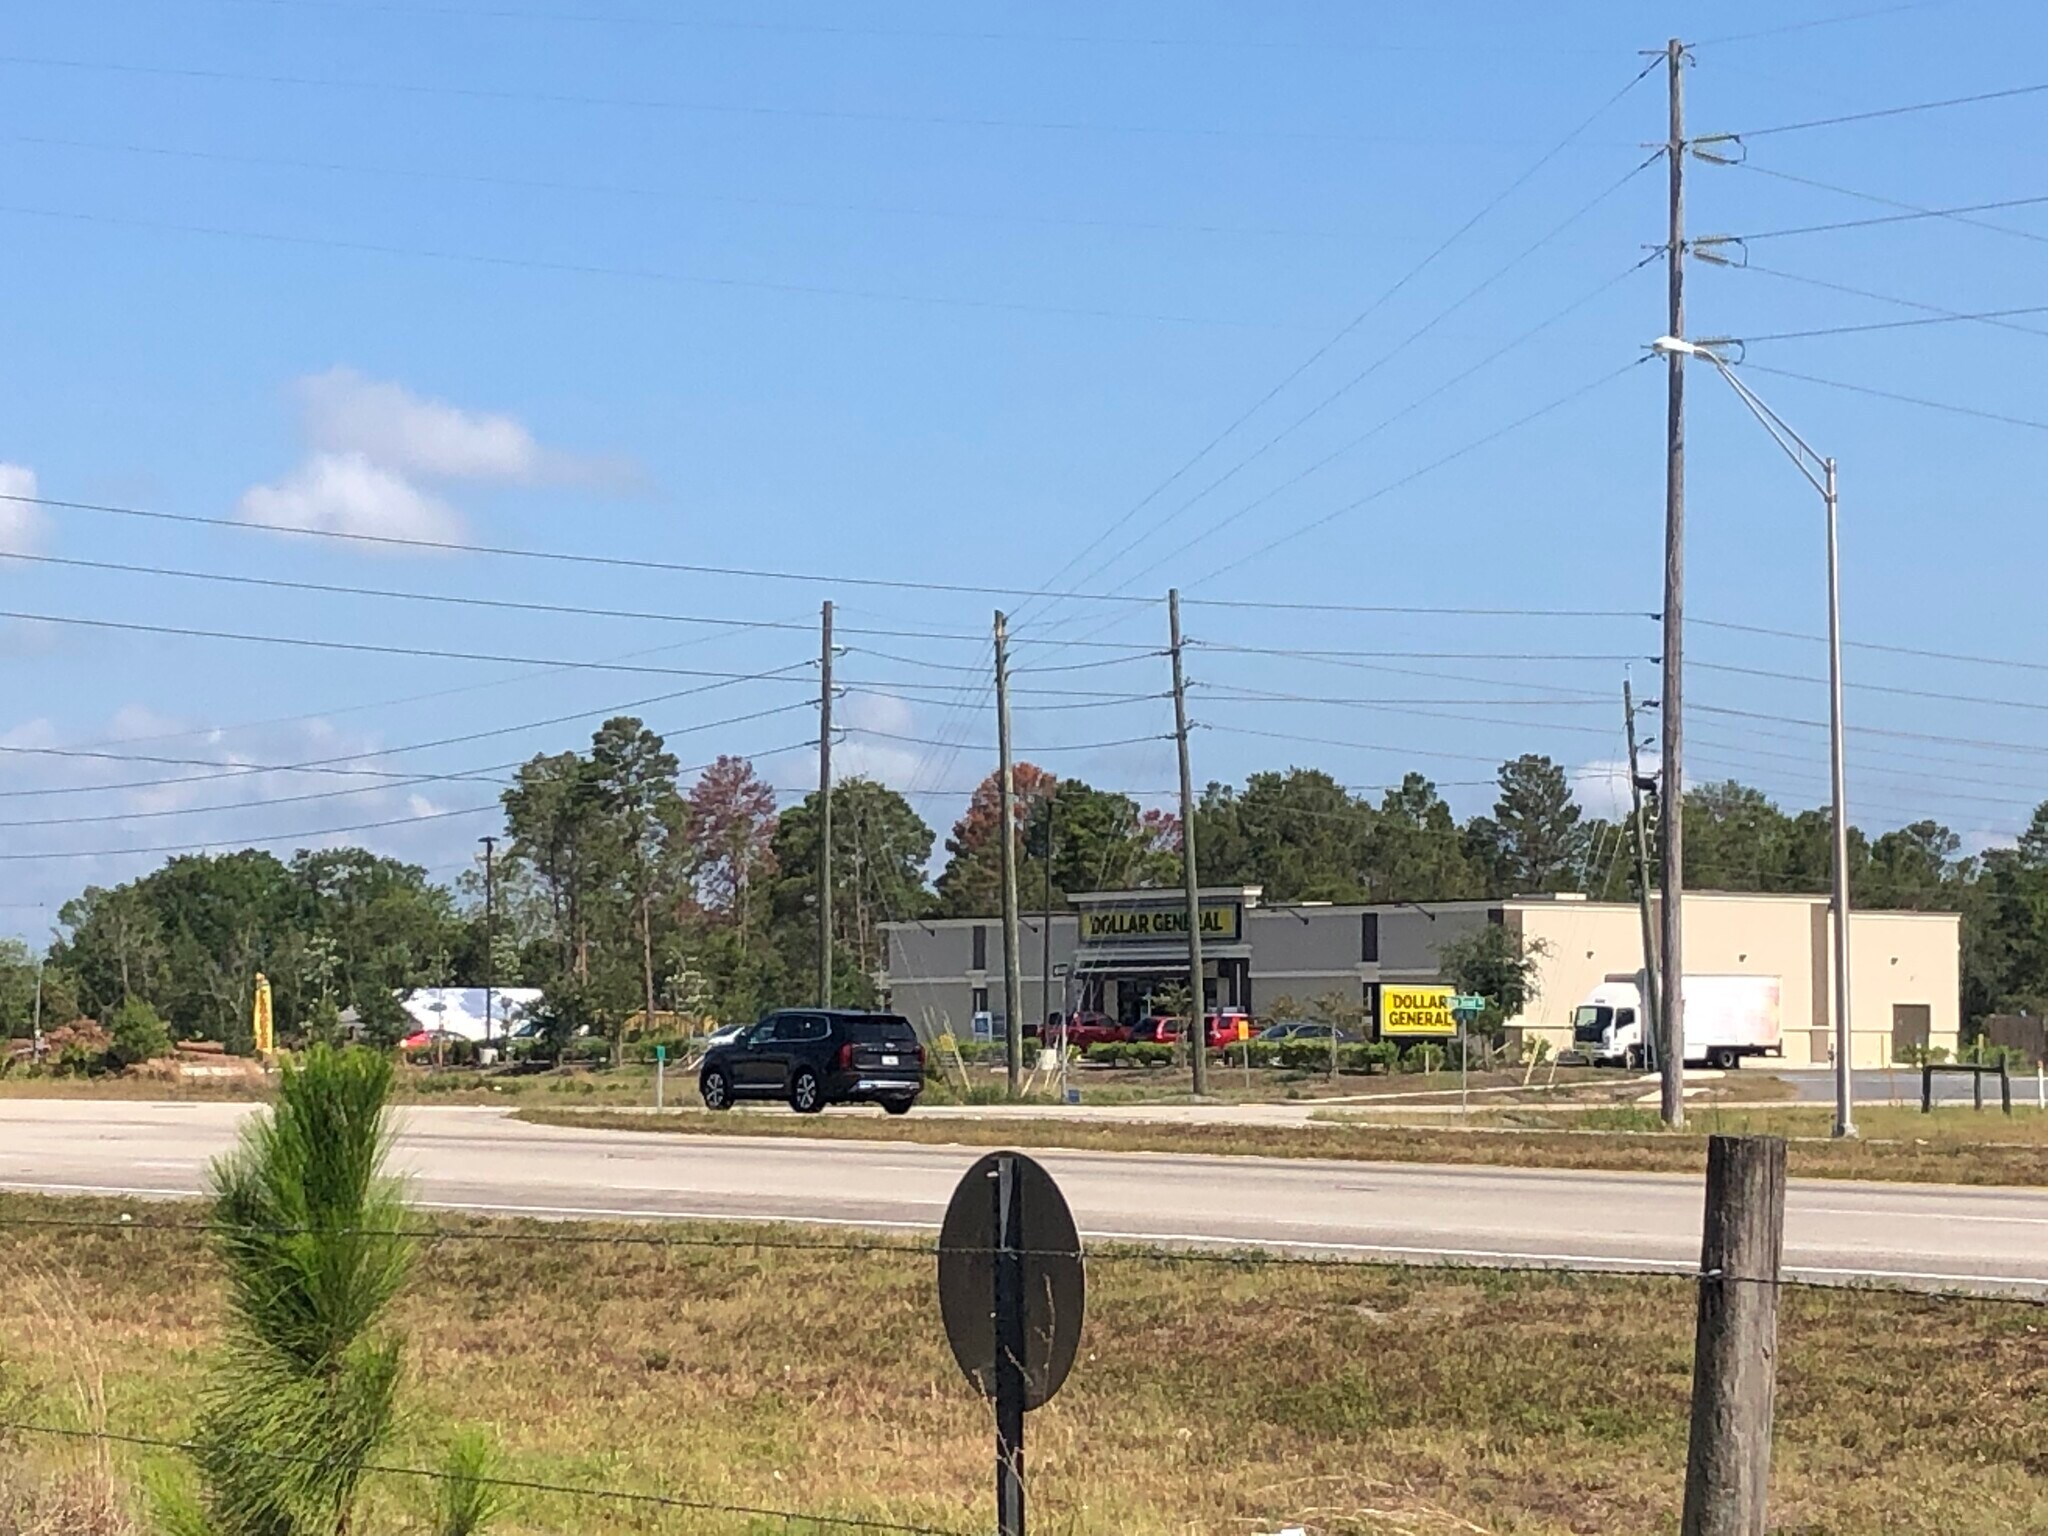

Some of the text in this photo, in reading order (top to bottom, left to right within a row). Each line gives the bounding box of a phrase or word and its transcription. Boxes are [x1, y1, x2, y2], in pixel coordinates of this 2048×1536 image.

[1090, 911, 1223, 934] DOLLAR GENEAL
[1392, 994, 1448, 1009] DOLLAR
[1389, 1011, 1452, 1026] GENERAL
